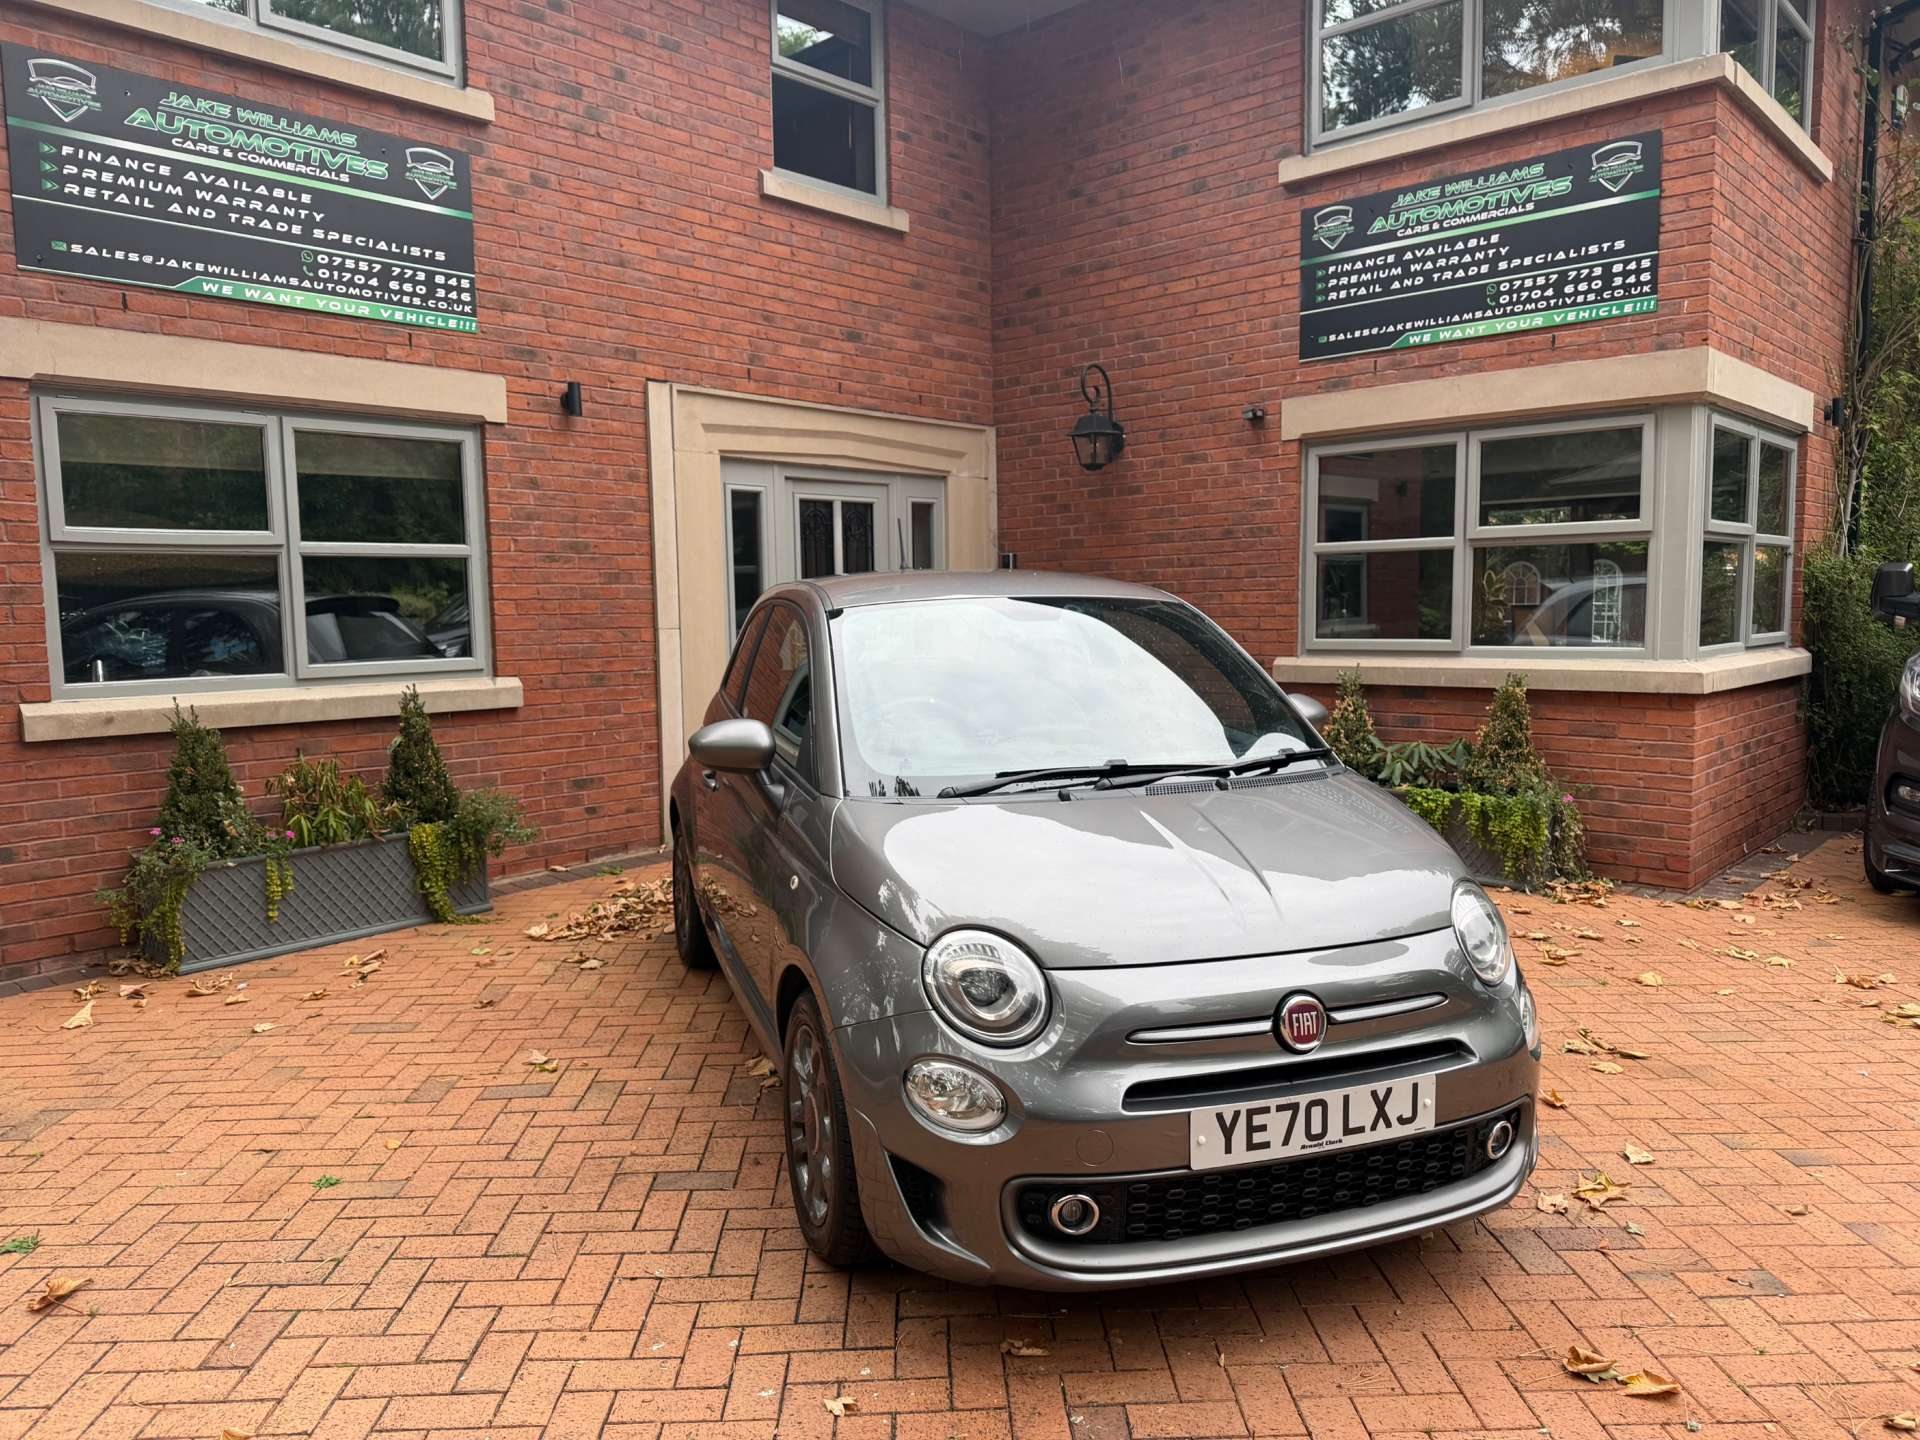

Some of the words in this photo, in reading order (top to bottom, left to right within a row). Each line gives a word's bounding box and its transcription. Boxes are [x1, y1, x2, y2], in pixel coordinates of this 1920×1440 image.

[124, 107, 389, 180] AUTOMOTIVES
[160, 91, 232, 118] JAKE
[236, 107, 358, 148] WILLIAMS
[61, 145, 172, 176] FINANCE
[183, 170, 313, 204] AVAILABLE
[171, 137, 220, 156] CARS
[222, 148, 234, 159] &
[237, 152, 350, 183] COMMERCIALS
[62, 164, 183, 196] PREMIUM
[195, 189, 325, 223] WARRANTY
[1367, 175, 1574, 235] AUTOMOTIVES
[1391, 185, 1442, 209] JAKE
[1444, 163, 1545, 197] WILLIAMS
[63, 183, 155, 208] RETAIL
[167, 202, 217, 219] AND
[228, 212, 303, 235] TRADE
[312, 228, 447, 261] SPECIALISTS
[1396, 222, 1431, 238] CARS
[1432, 221, 1440, 230] &
[1443, 202, 1535, 229] COMMERCIALS
[317, 254, 382, 273] 07557
[391, 266, 426, 281] 773
[434, 275, 471, 289] 845
[1327, 267, 1402, 288] PREMIUM
[1410, 246, 1510, 273] WARRANTY
[1327, 285, 1383, 301] RETAIL
[1390, 276, 1424, 290] AND
[1432, 264, 1490, 282] TRADE
[1497, 239, 1626, 271] SPECIALISTS
[1328, 253, 1396, 275] FINANCE
[1402, 233, 1500, 261] AVAILABLE
[1500, 274, 1558, 291] 07557
[1567, 267, 1603, 281] 773
[1611, 258, 1652, 273] 845
[70, 244, 472, 314] SALES@JAKEWILLIAMSAUTOMOTIVES.CO.UK
[317, 268, 380, 287] 01704
[388, 280, 427, 295] 660
[435, 288, 472, 302] 346
[1499, 287, 1554, 304] 01704
[1564, 280, 1602, 294] 660
[1611, 272, 1652, 287] 346
[202, 280, 234, 297] WE
[245, 287, 305, 307] WANT
[315, 298, 370, 315] YOUR
[379, 308, 477, 331] VEHICLE!!!
[1328, 284, 1652, 343] SALES@JAKEWILLIAMSAUTOMOTIVES.CO.UK
[1409, 333, 1432, 344] WE
[1439, 325, 1487, 341] WANT
[1496, 316, 1545, 332] YOUR
[1553, 300, 1655, 323] VEHICLE!!!
[1292, 1010, 1318, 1036] FIAT
[1215, 1097, 1329, 1154] YE70
[1342, 1082, 1419, 1137] LXJ
